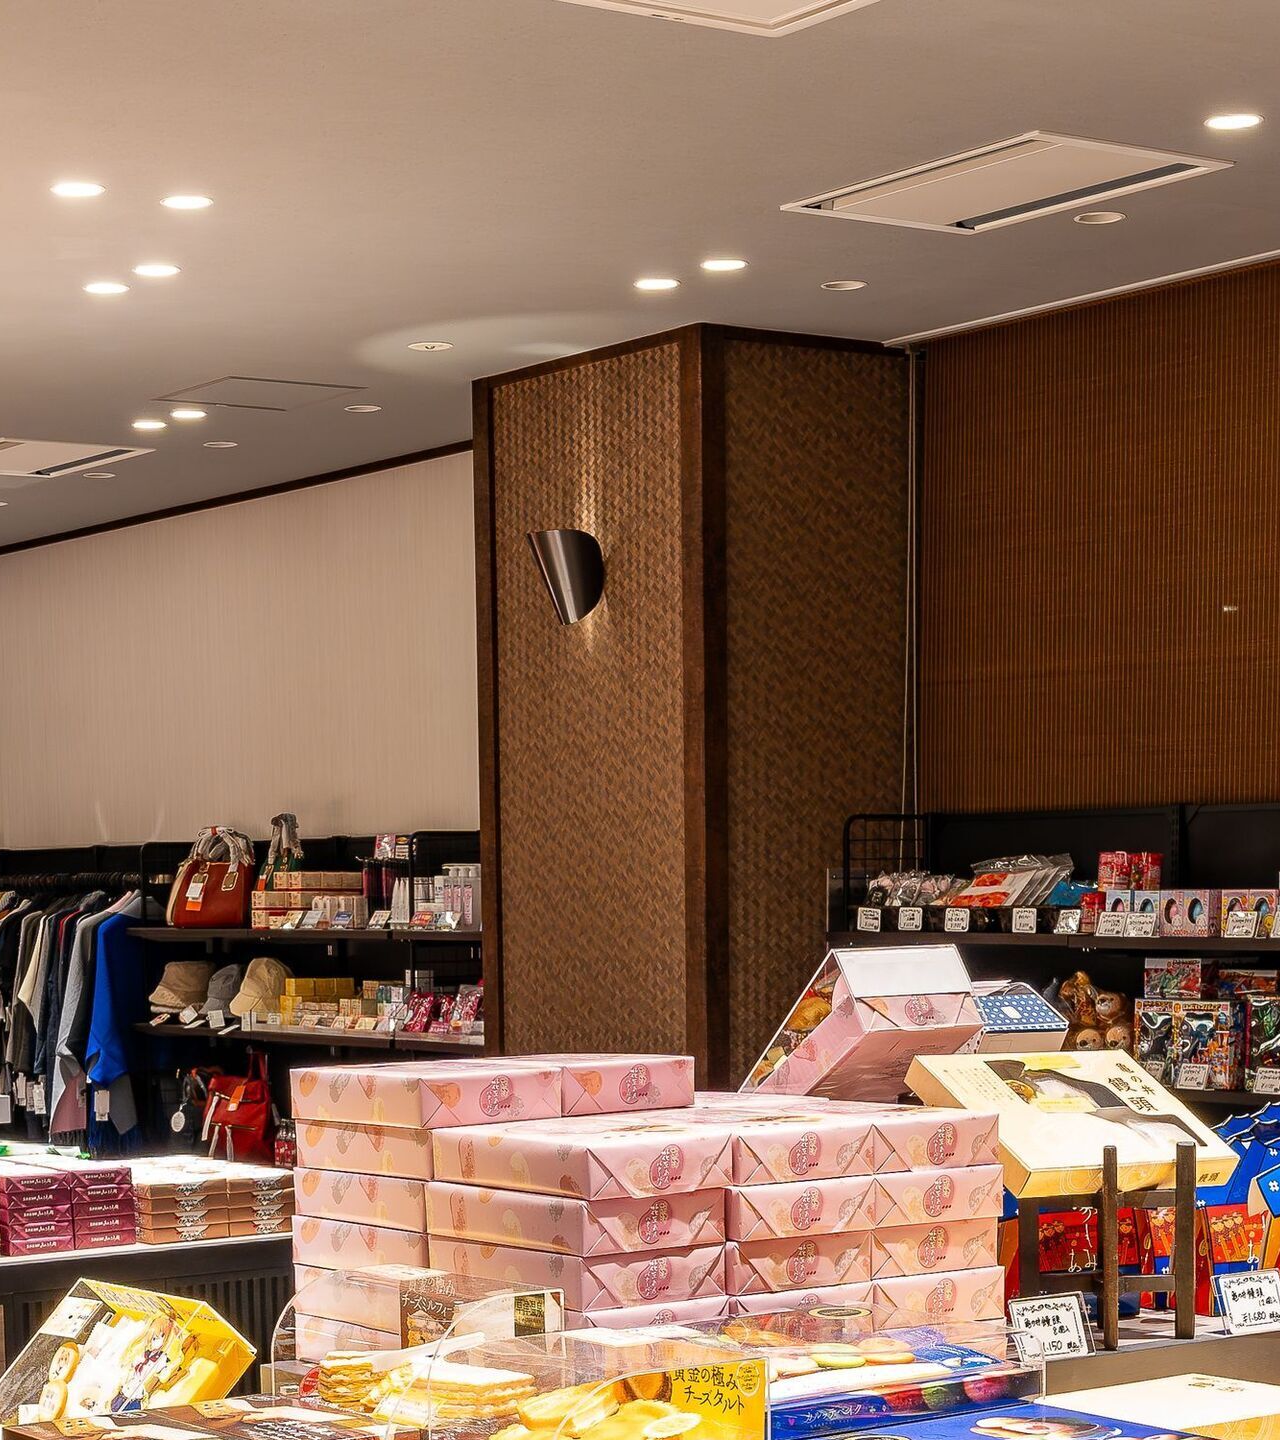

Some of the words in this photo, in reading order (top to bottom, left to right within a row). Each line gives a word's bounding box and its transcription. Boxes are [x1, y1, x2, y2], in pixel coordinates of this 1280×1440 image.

[684, 1385, 744, 1415] チーズタルト
